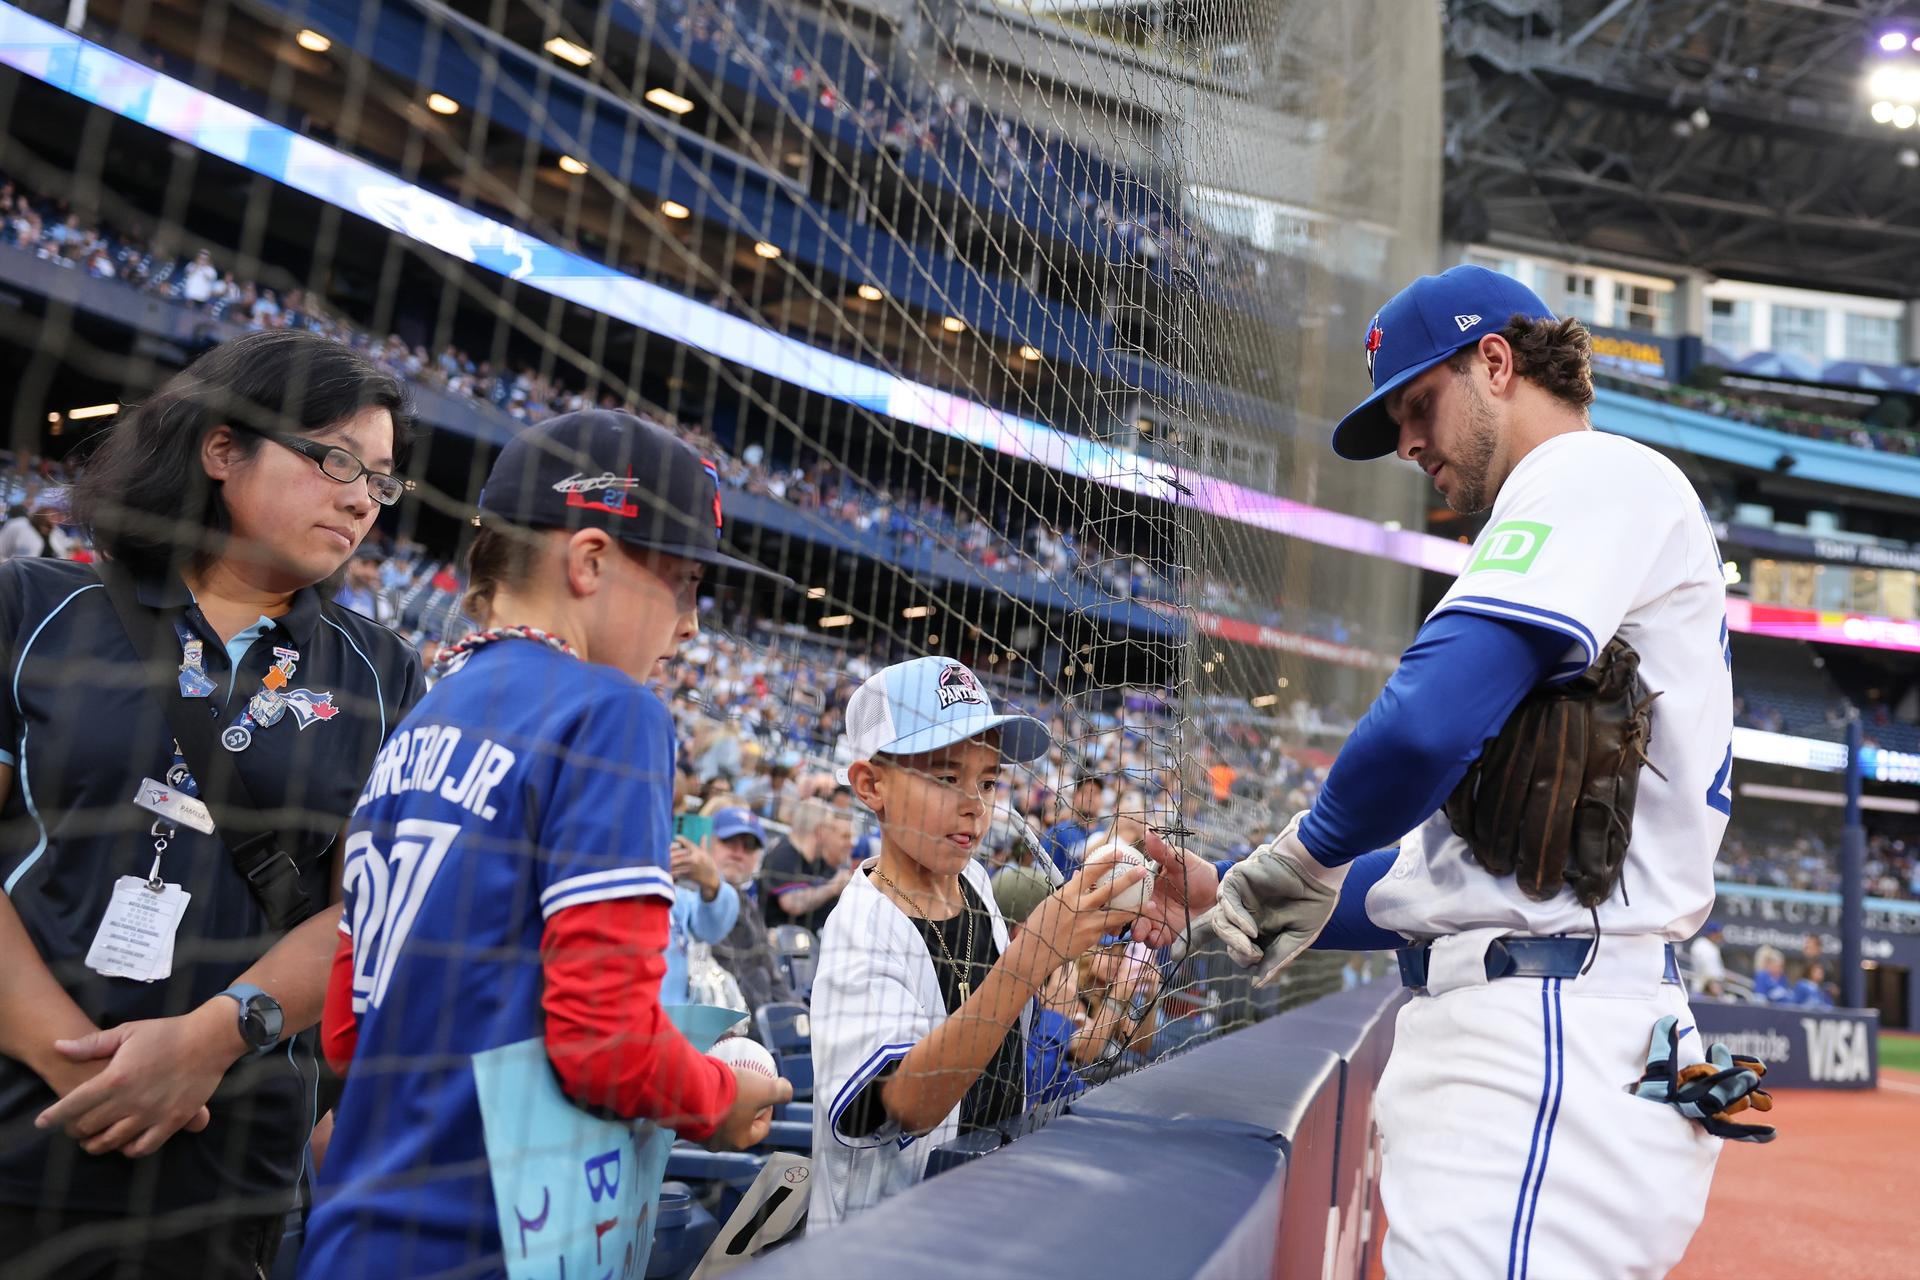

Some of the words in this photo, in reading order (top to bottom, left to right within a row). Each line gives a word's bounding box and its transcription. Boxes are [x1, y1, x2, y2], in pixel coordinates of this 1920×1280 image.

[603, 488, 627, 509] 27
[1483, 529, 1536, 562] TD
[227, 731, 246, 747] 32
[440, 739, 516, 822] JR.
[342, 818, 462, 1014] 27
[1801, 1017, 1871, 1082] VISA
